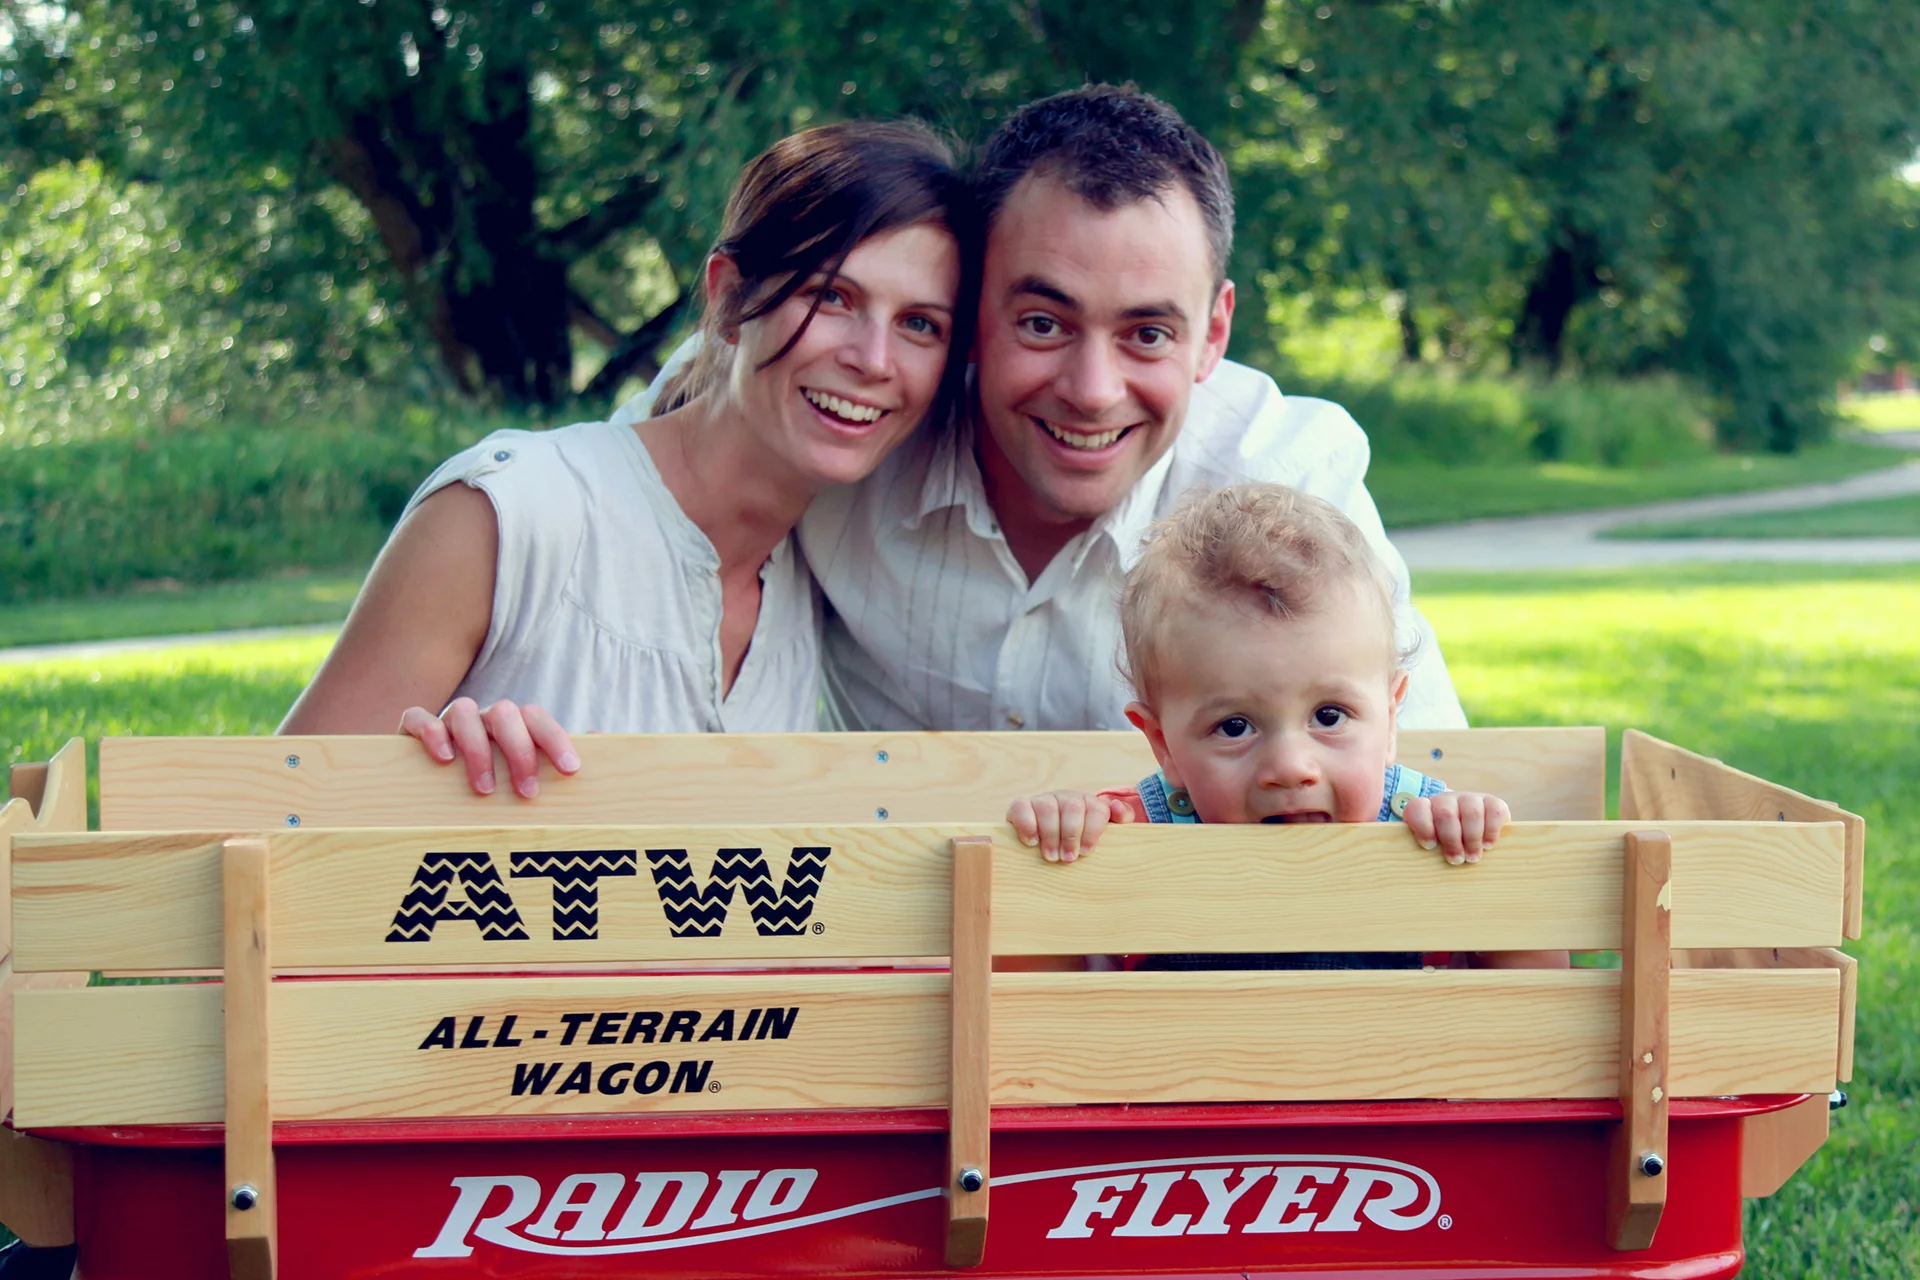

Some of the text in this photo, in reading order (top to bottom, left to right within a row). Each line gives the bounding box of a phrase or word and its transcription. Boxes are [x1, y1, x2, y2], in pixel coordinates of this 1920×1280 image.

[385, 847, 832, 942] ATW
[510, 1060, 714, 1096] WAGON
[412, 1155, 1442, 1258] RADIO FLYER
